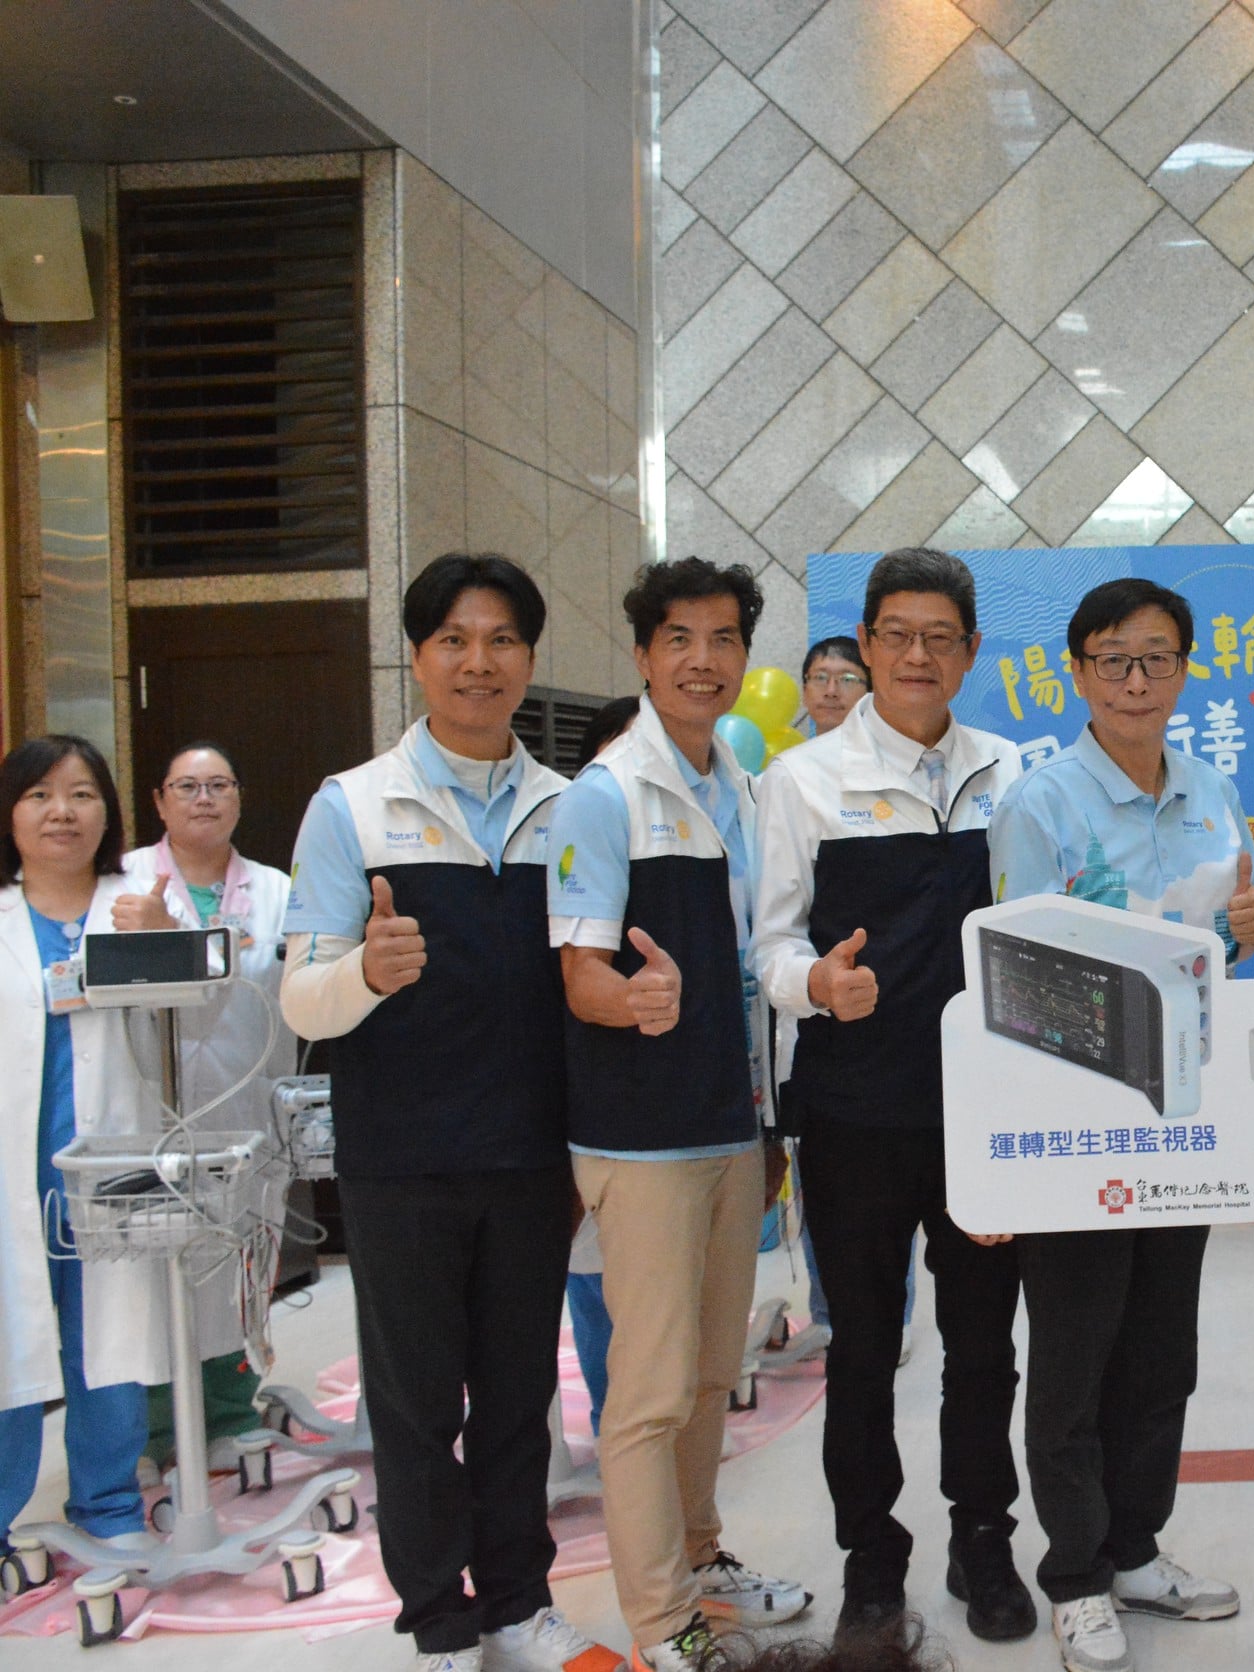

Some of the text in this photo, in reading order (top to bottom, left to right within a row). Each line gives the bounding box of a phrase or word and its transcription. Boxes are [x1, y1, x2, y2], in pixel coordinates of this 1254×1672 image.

[840, 809, 872, 818] Rotary
[386, 831, 421, 841] Rotary
[1178, 1031, 1187, 1074] IntelliVue
[989, 1124, 1217, 1160] 運轉型生理監視器
